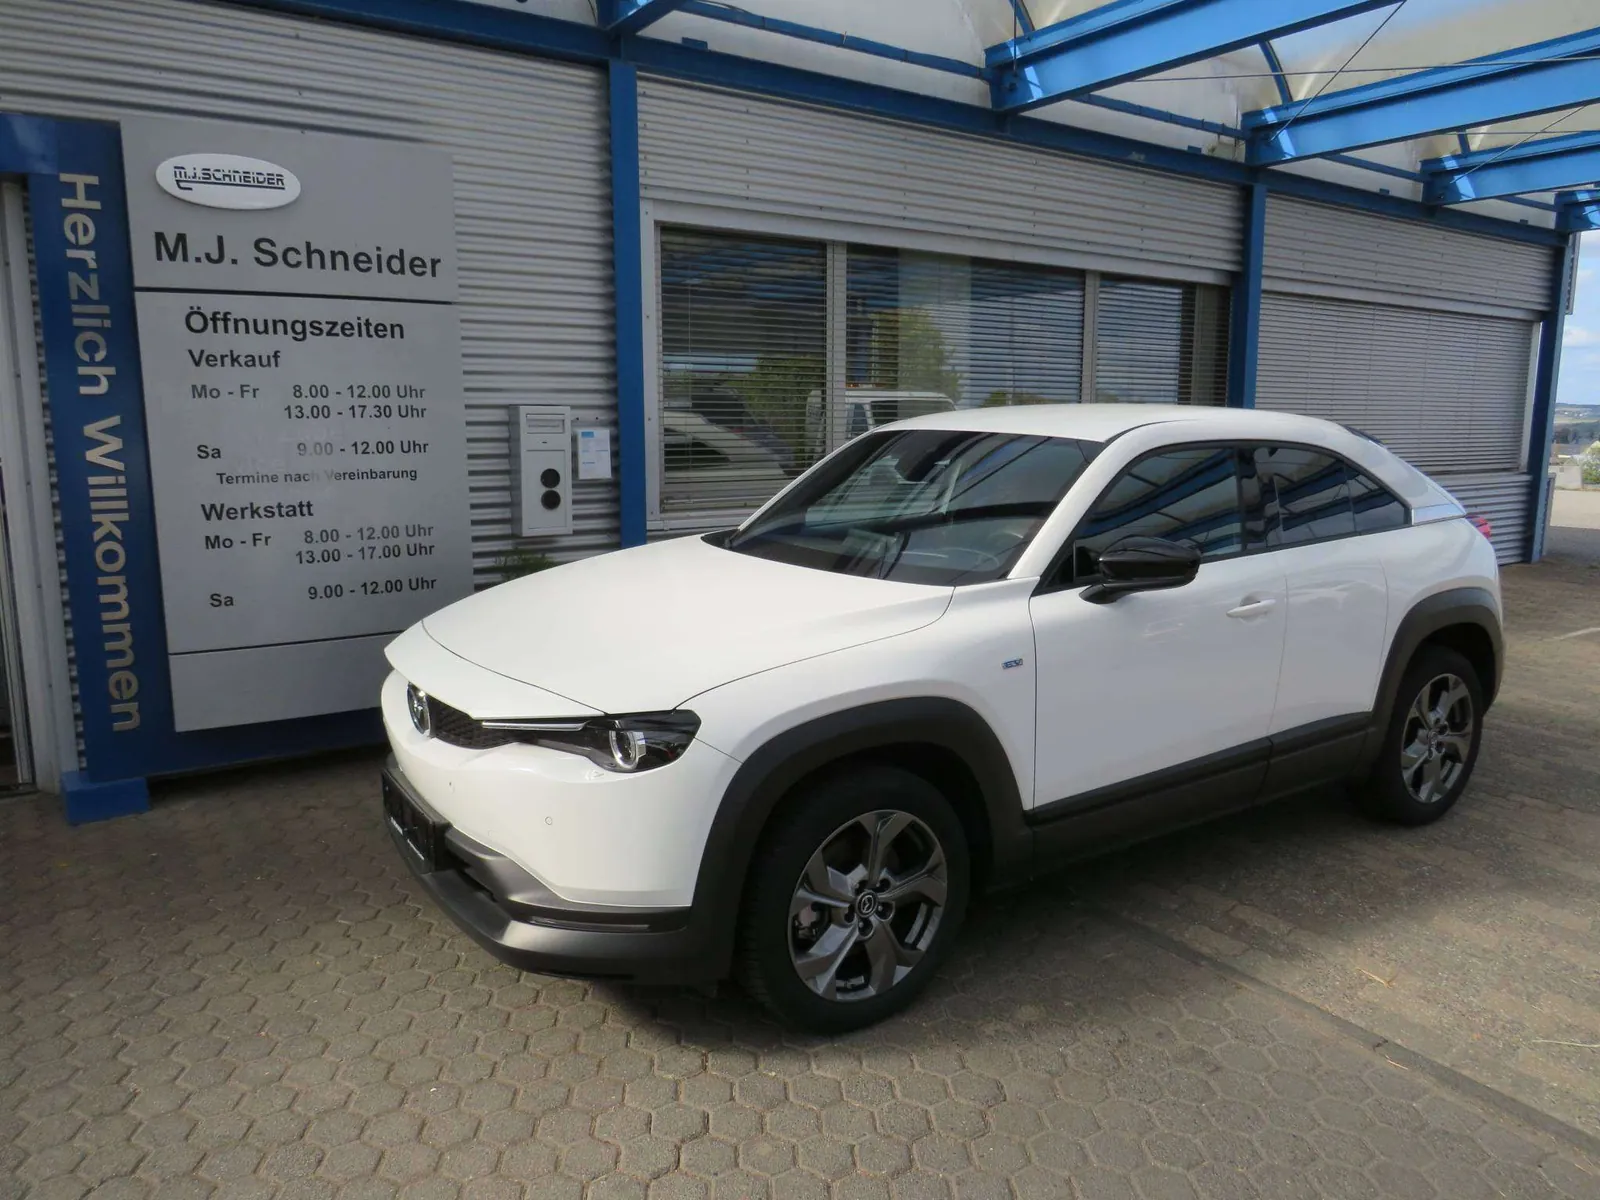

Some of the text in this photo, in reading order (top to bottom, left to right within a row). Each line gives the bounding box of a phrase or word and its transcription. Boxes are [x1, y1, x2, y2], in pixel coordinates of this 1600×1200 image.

[153, 231, 442, 278] M.J. Schneider
[184, 305, 405, 342] Öffnungszeiten
[187, 348, 281, 368] Verkauf
[190, 383, 221, 400] Mo
[239, 383, 260, 399] Fr
[292, 384, 330, 399] 8.00
[346, 384, 391, 399] 12.00
[396, 384, 426, 399] Uhr
[283, 404, 331, 420] 13.00
[348, 404, 393, 419] 17.30
[397, 404, 427, 419] Uhr
[59, 173, 141, 732] Herzlich Willkommen
[196, 444, 222, 460] Sa
[296, 441, 334, 457] 9.00
[351, 440, 395, 455] 12.00
[399, 439, 429, 454] Uhr
[215, 468, 418, 485] Termine nach Vereinbarung
[200, 500, 314, 522] Werkstatt
[204, 534, 234, 550] Mo
[251, 532, 272, 548] Fr
[303, 528, 340, 545] 8.00
[356, 525, 400, 541] 12.00
[405, 523, 434, 538] Uhr
[295, 548, 341, 565] 13.00
[357, 543, 402, 561] 17.00
[406, 542, 436, 557] Uhr
[209, 592, 235, 608] Sa
[307, 583, 344, 600] 9.00
[360, 578, 404, 596] 12.00
[408, 576, 438, 592] Uhr
